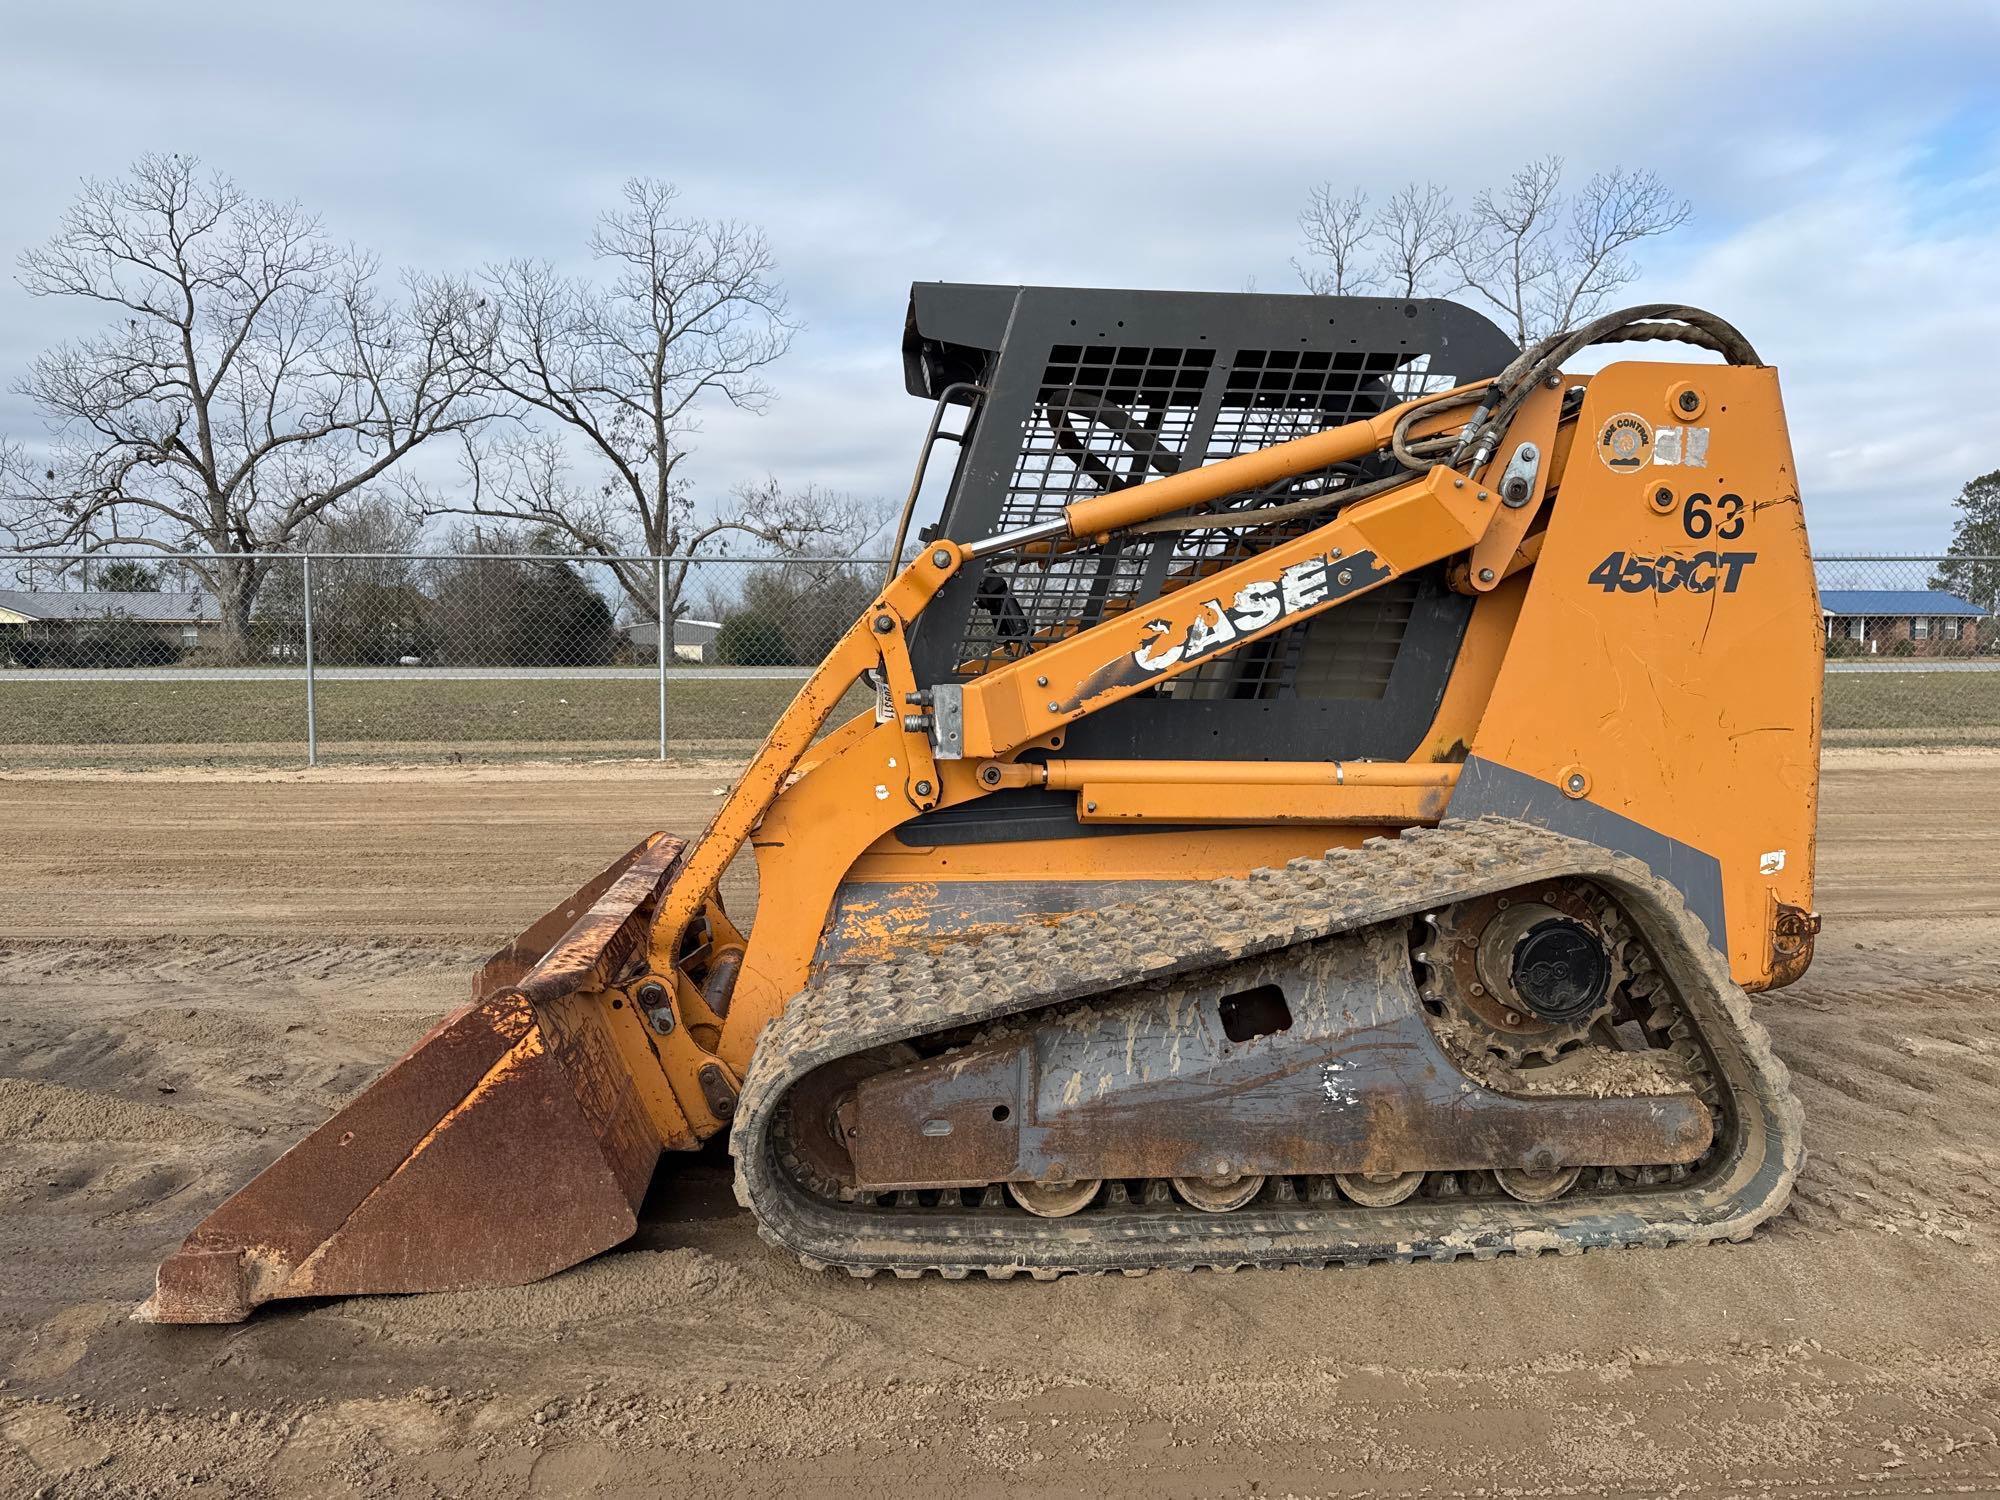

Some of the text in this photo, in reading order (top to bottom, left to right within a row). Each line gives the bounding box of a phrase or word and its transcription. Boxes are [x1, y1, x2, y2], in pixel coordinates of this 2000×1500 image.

[1603, 418, 1649, 447] RIDE CONTROL
[1683, 492, 1745, 540] 63
[1588, 551, 1757, 594] 450CT
